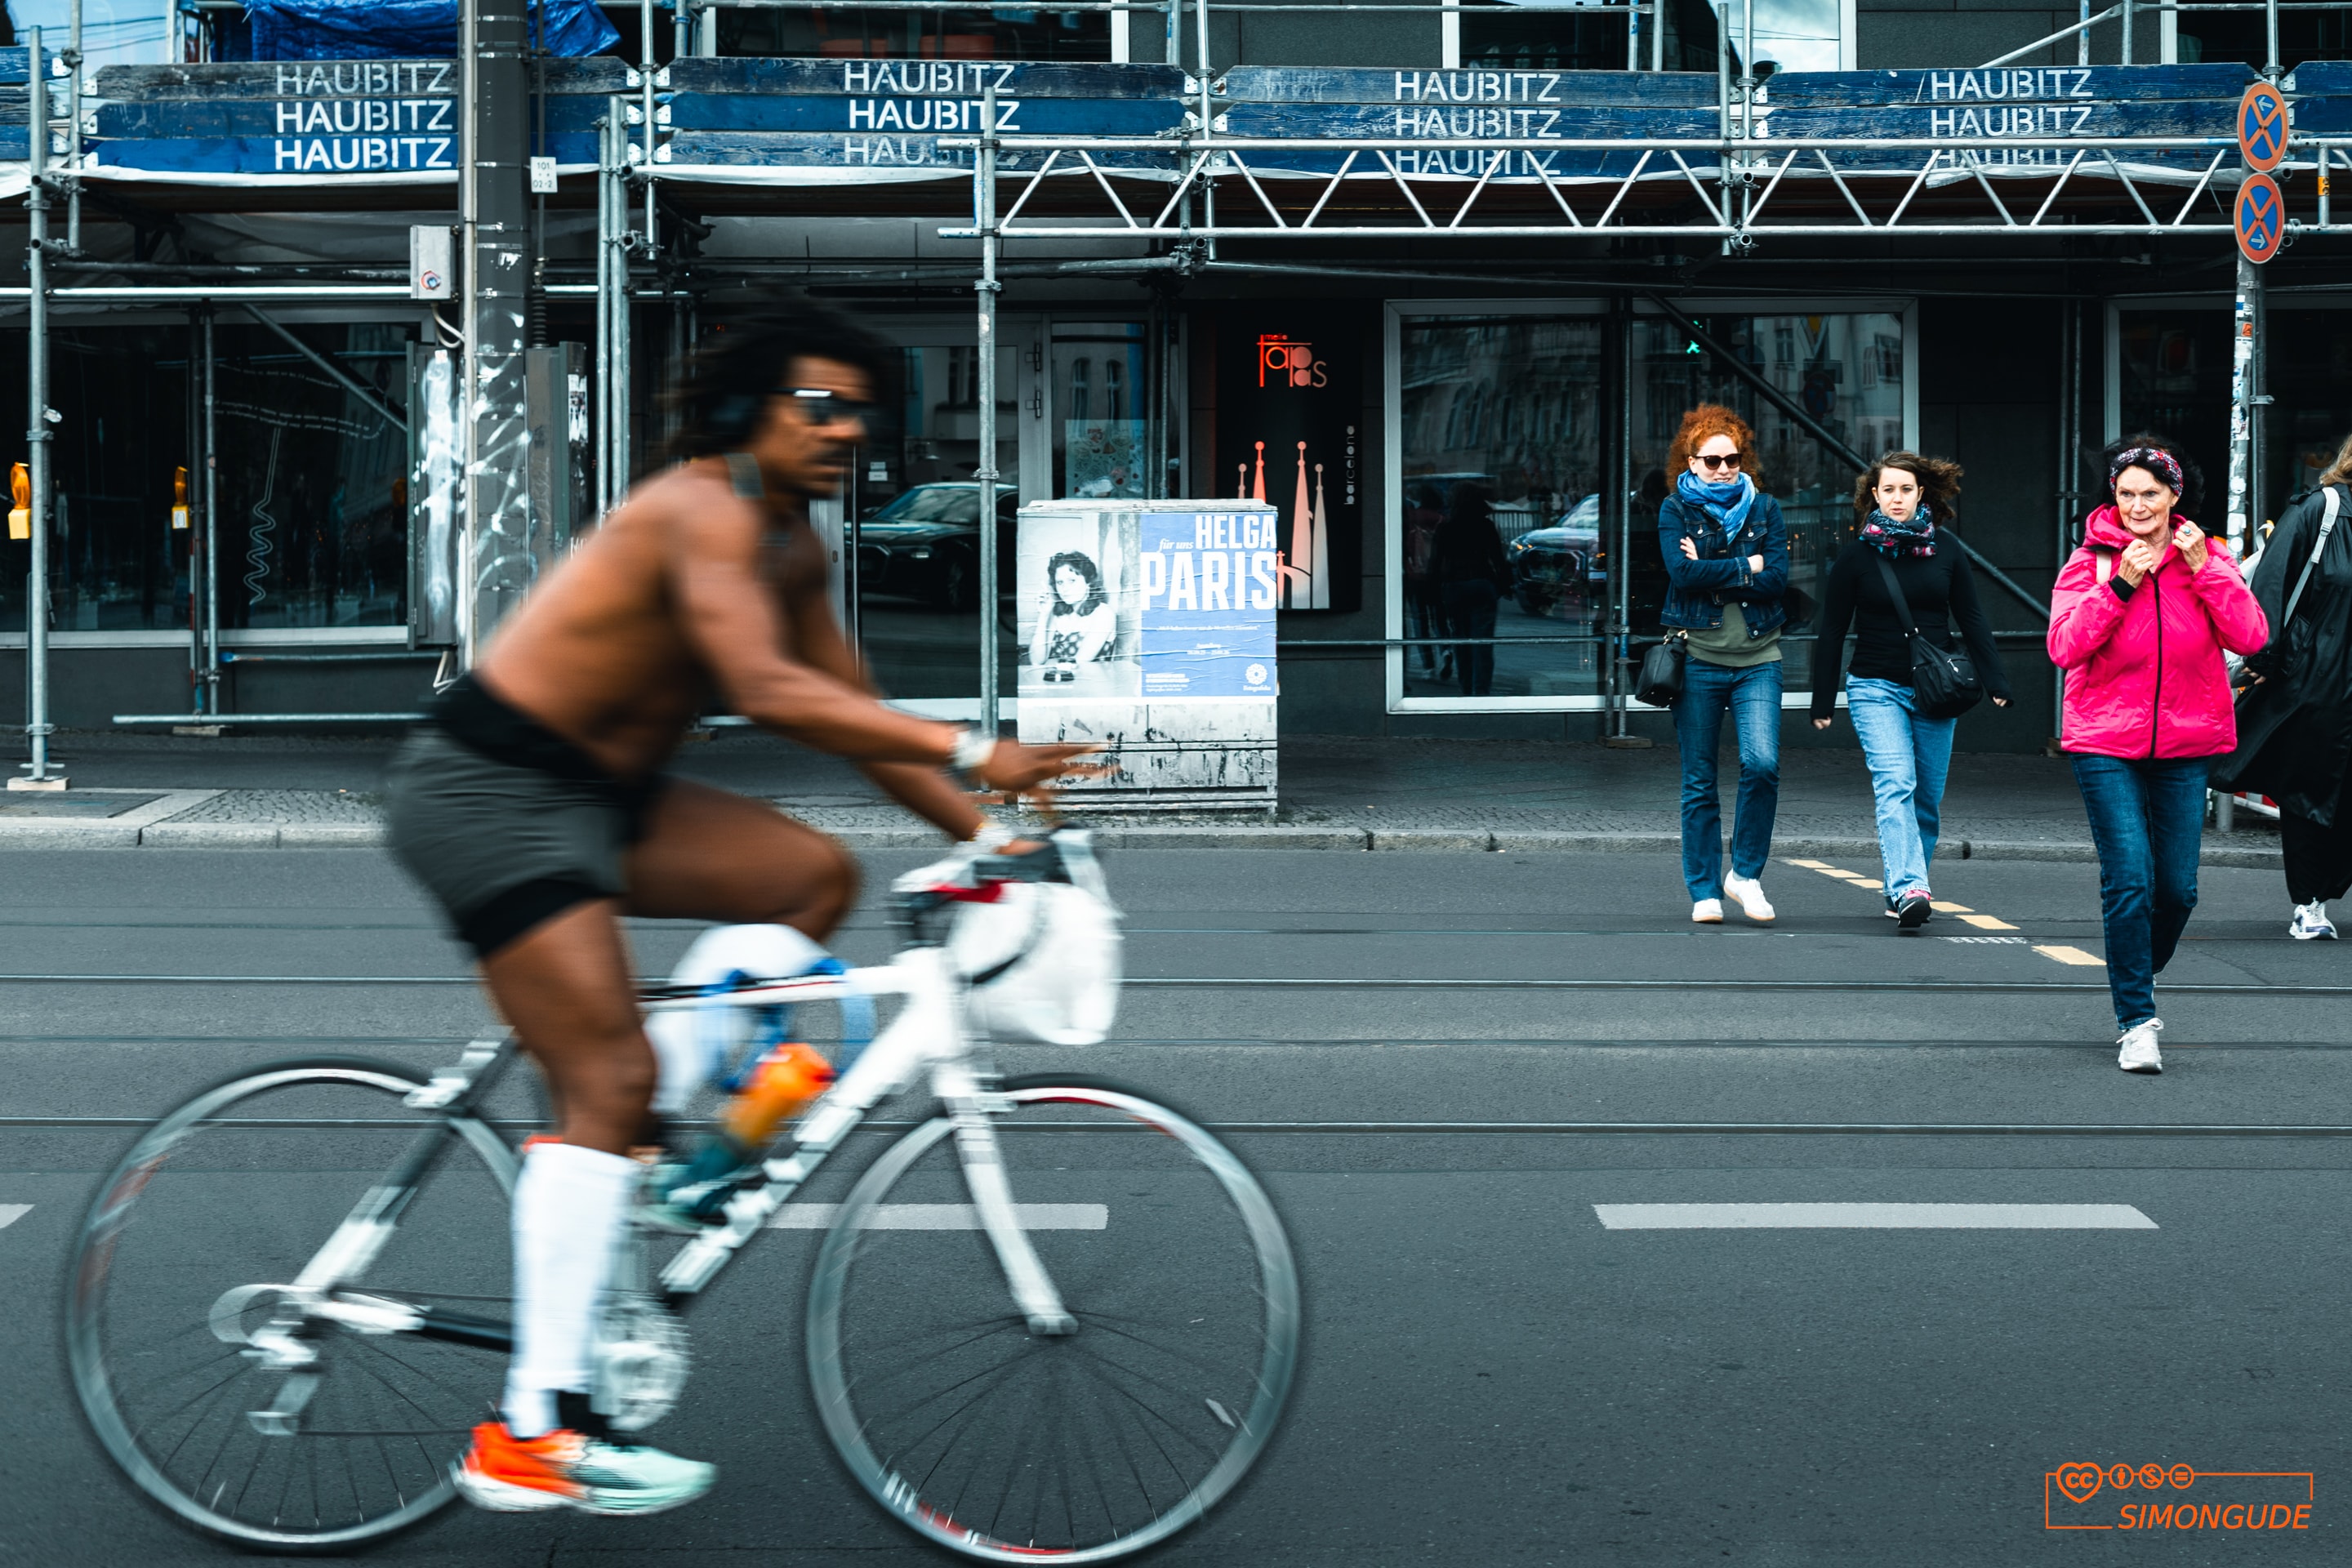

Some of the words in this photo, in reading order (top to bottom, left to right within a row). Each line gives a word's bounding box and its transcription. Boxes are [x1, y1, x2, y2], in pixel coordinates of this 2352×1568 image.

[276, 63, 451, 95] HAUBITZ
[844, 62, 1015, 93] HAUBITZ
[1395, 71, 1561, 102] HAUBITZ
[1931, 69, 2093, 100] HAUBITZ
[276, 100, 452, 133] HAUBITZ
[849, 99, 1020, 131] HAUBITZ
[1395, 108, 1561, 138] HAUBITZ
[1931, 106, 2092, 137] HAUBITZ
[274, 137, 452, 170] HAUBITZ
[1156, 538, 1175, 554] für
[1176, 541, 1194, 550] uns
[1195, 514, 1276, 550] HELGA
[1141, 551, 1276, 611] PARIS
